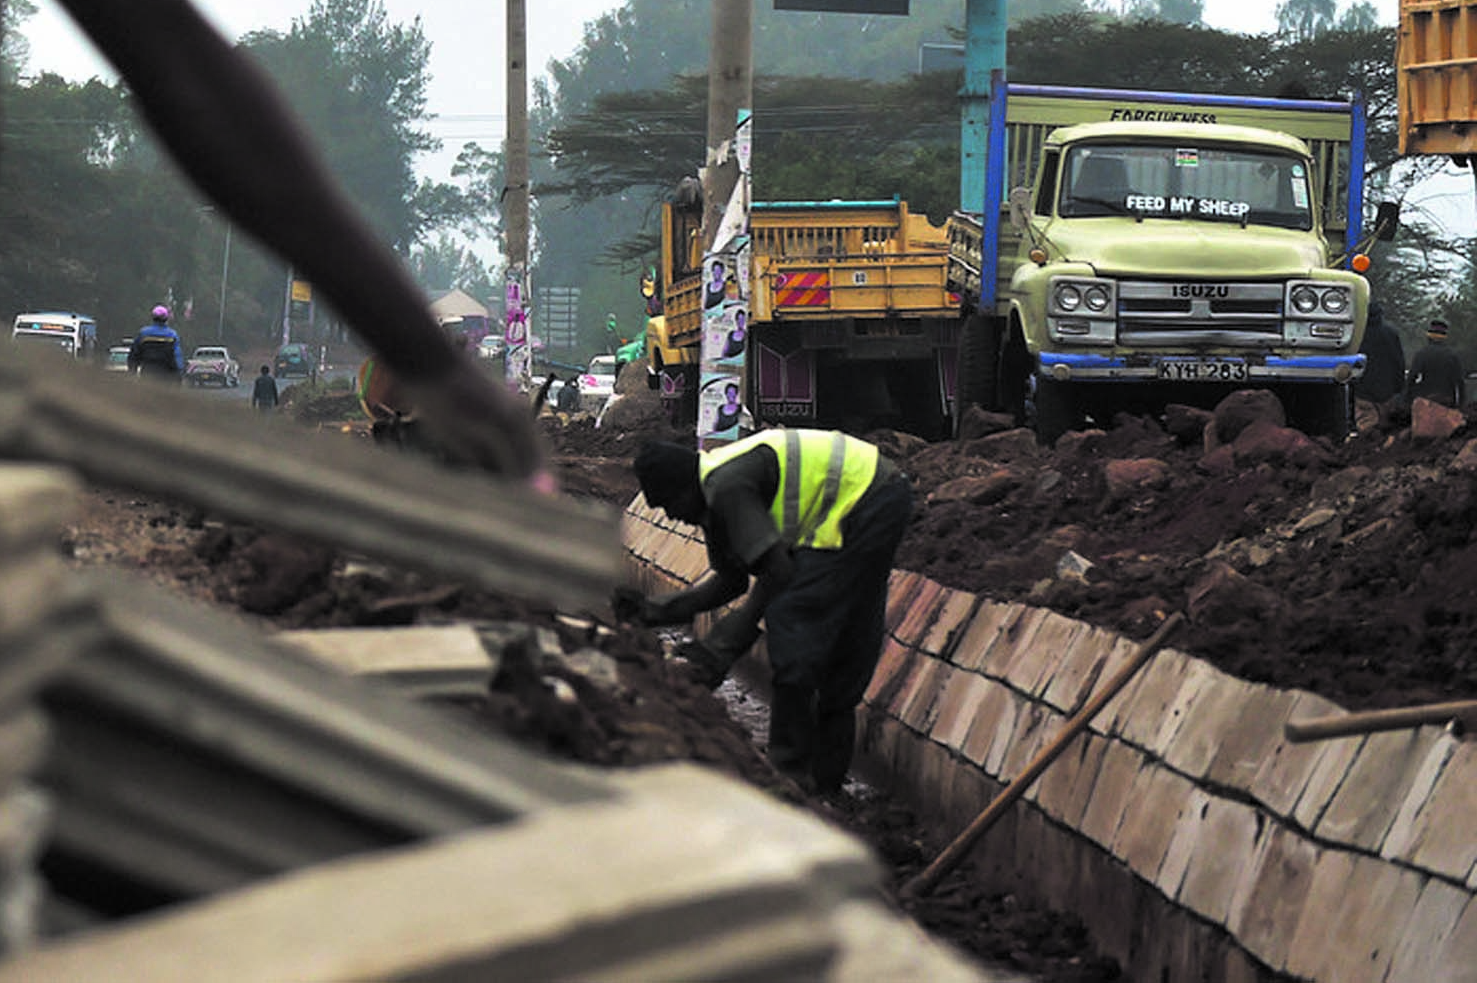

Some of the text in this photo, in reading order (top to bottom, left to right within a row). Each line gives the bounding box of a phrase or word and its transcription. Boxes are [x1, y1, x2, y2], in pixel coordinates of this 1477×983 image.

[1126, 195, 1250, 217] FEED MY SHEEP
[1172, 285, 1229, 298] ISUZU
[1162, 362, 1245, 380] KYH 283
